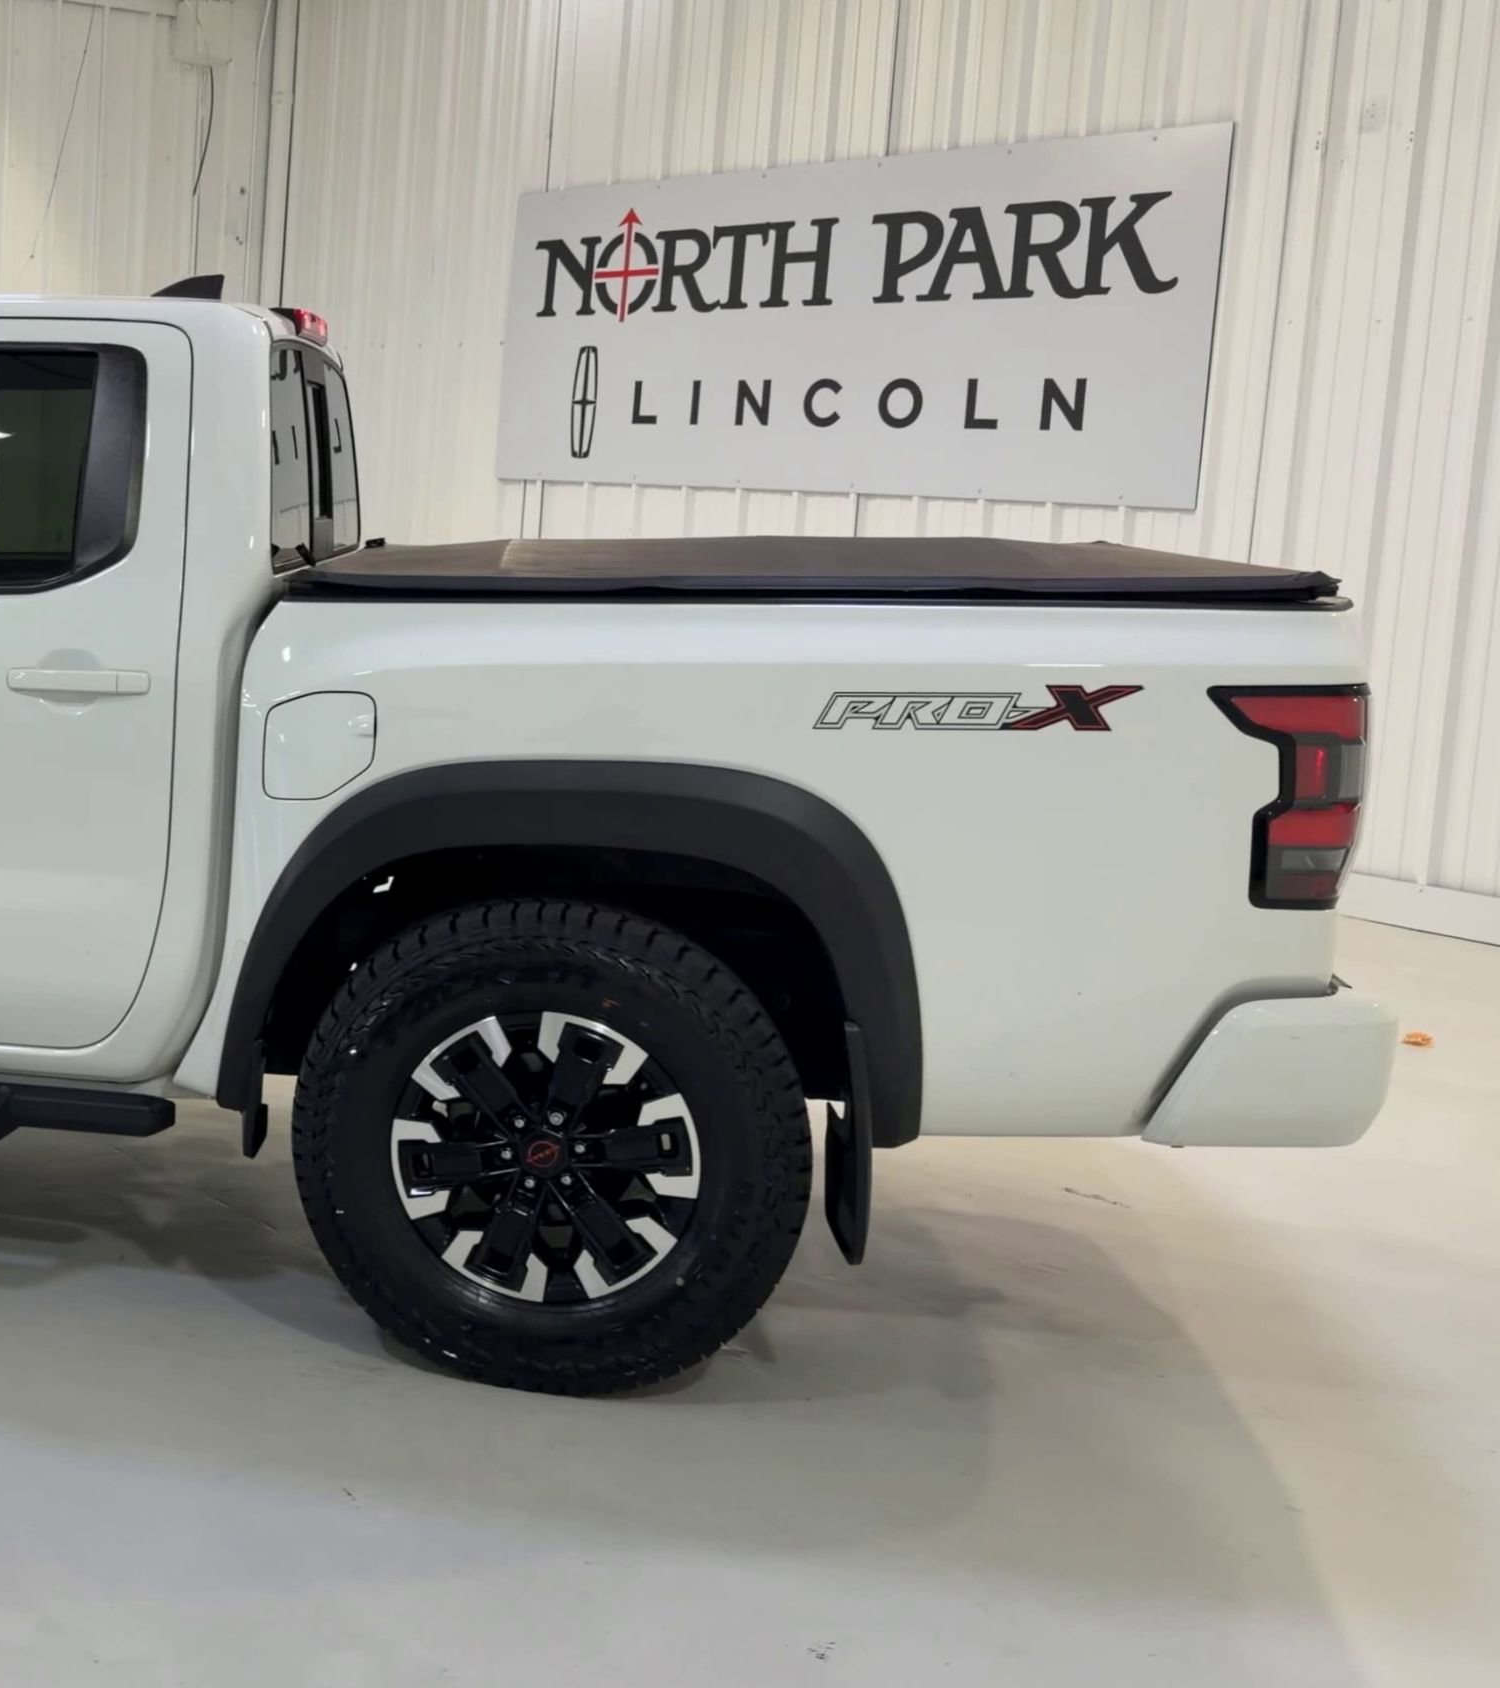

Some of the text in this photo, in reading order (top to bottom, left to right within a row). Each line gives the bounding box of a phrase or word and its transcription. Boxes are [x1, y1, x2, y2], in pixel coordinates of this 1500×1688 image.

[535, 190, 1179, 319] NORTH PARK
[631, 378, 1088, 431] LINCOLN
